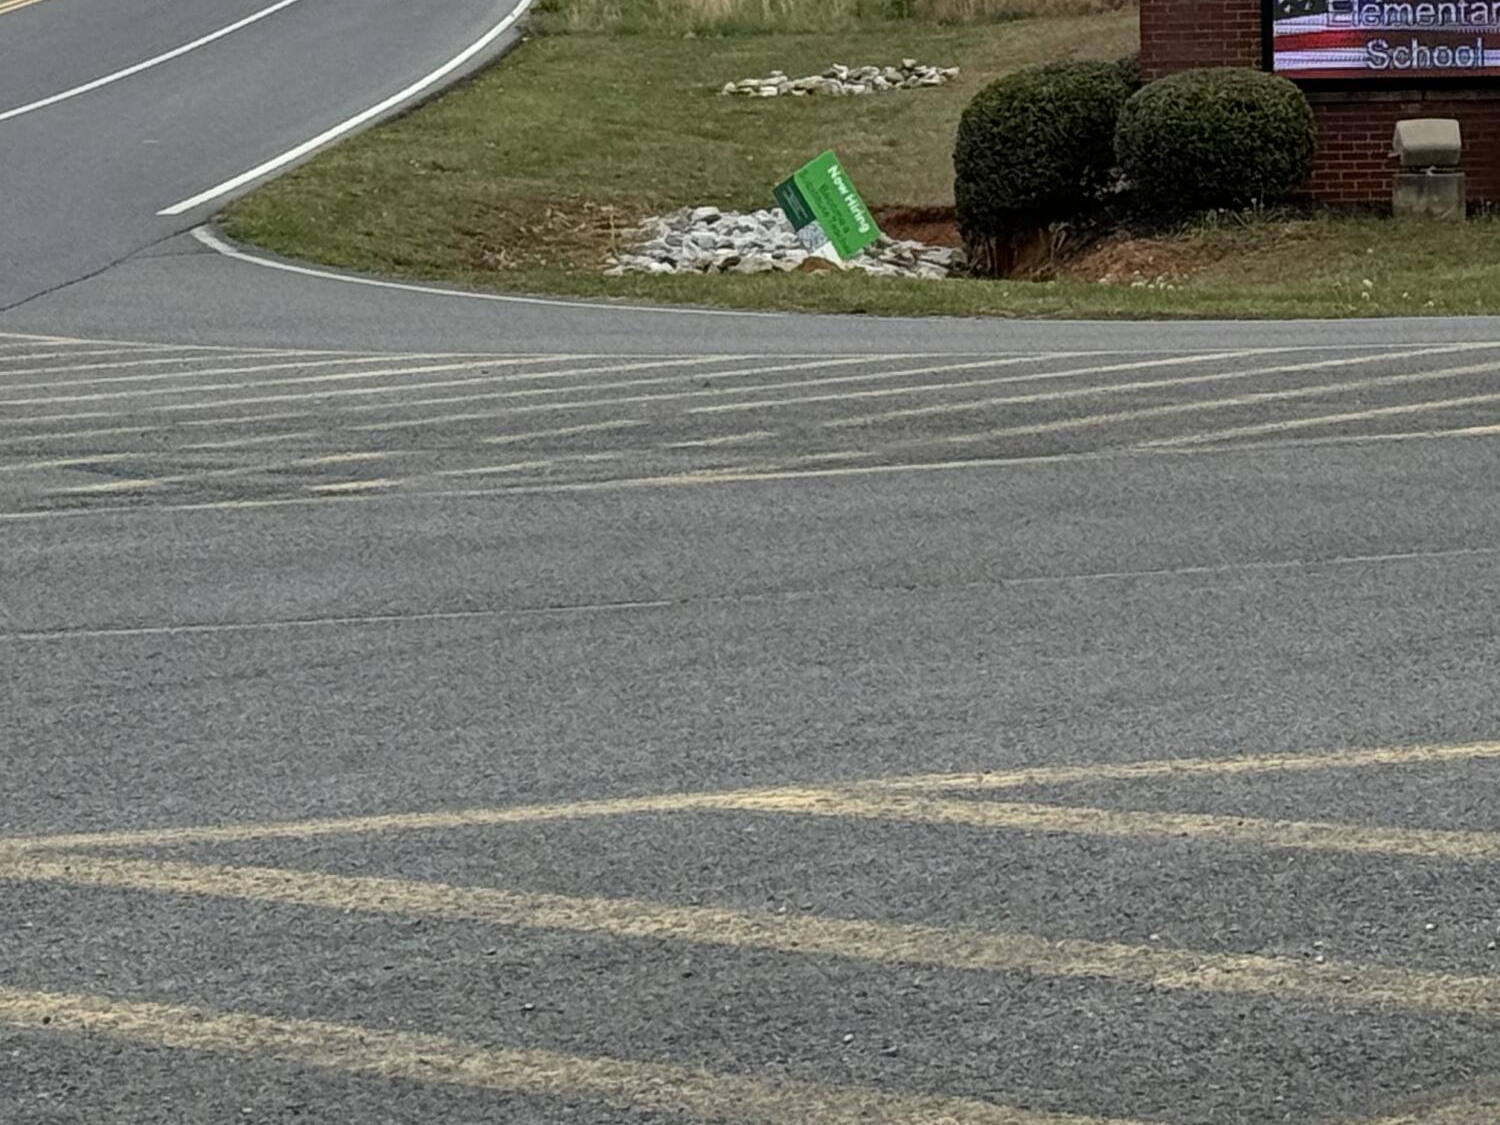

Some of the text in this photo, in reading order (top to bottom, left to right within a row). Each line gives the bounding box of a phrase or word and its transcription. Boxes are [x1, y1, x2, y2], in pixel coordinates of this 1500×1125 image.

[1366, 38, 1483, 69] School
[828, 164, 849, 194] Now
[845, 194, 870, 233] Hiring
